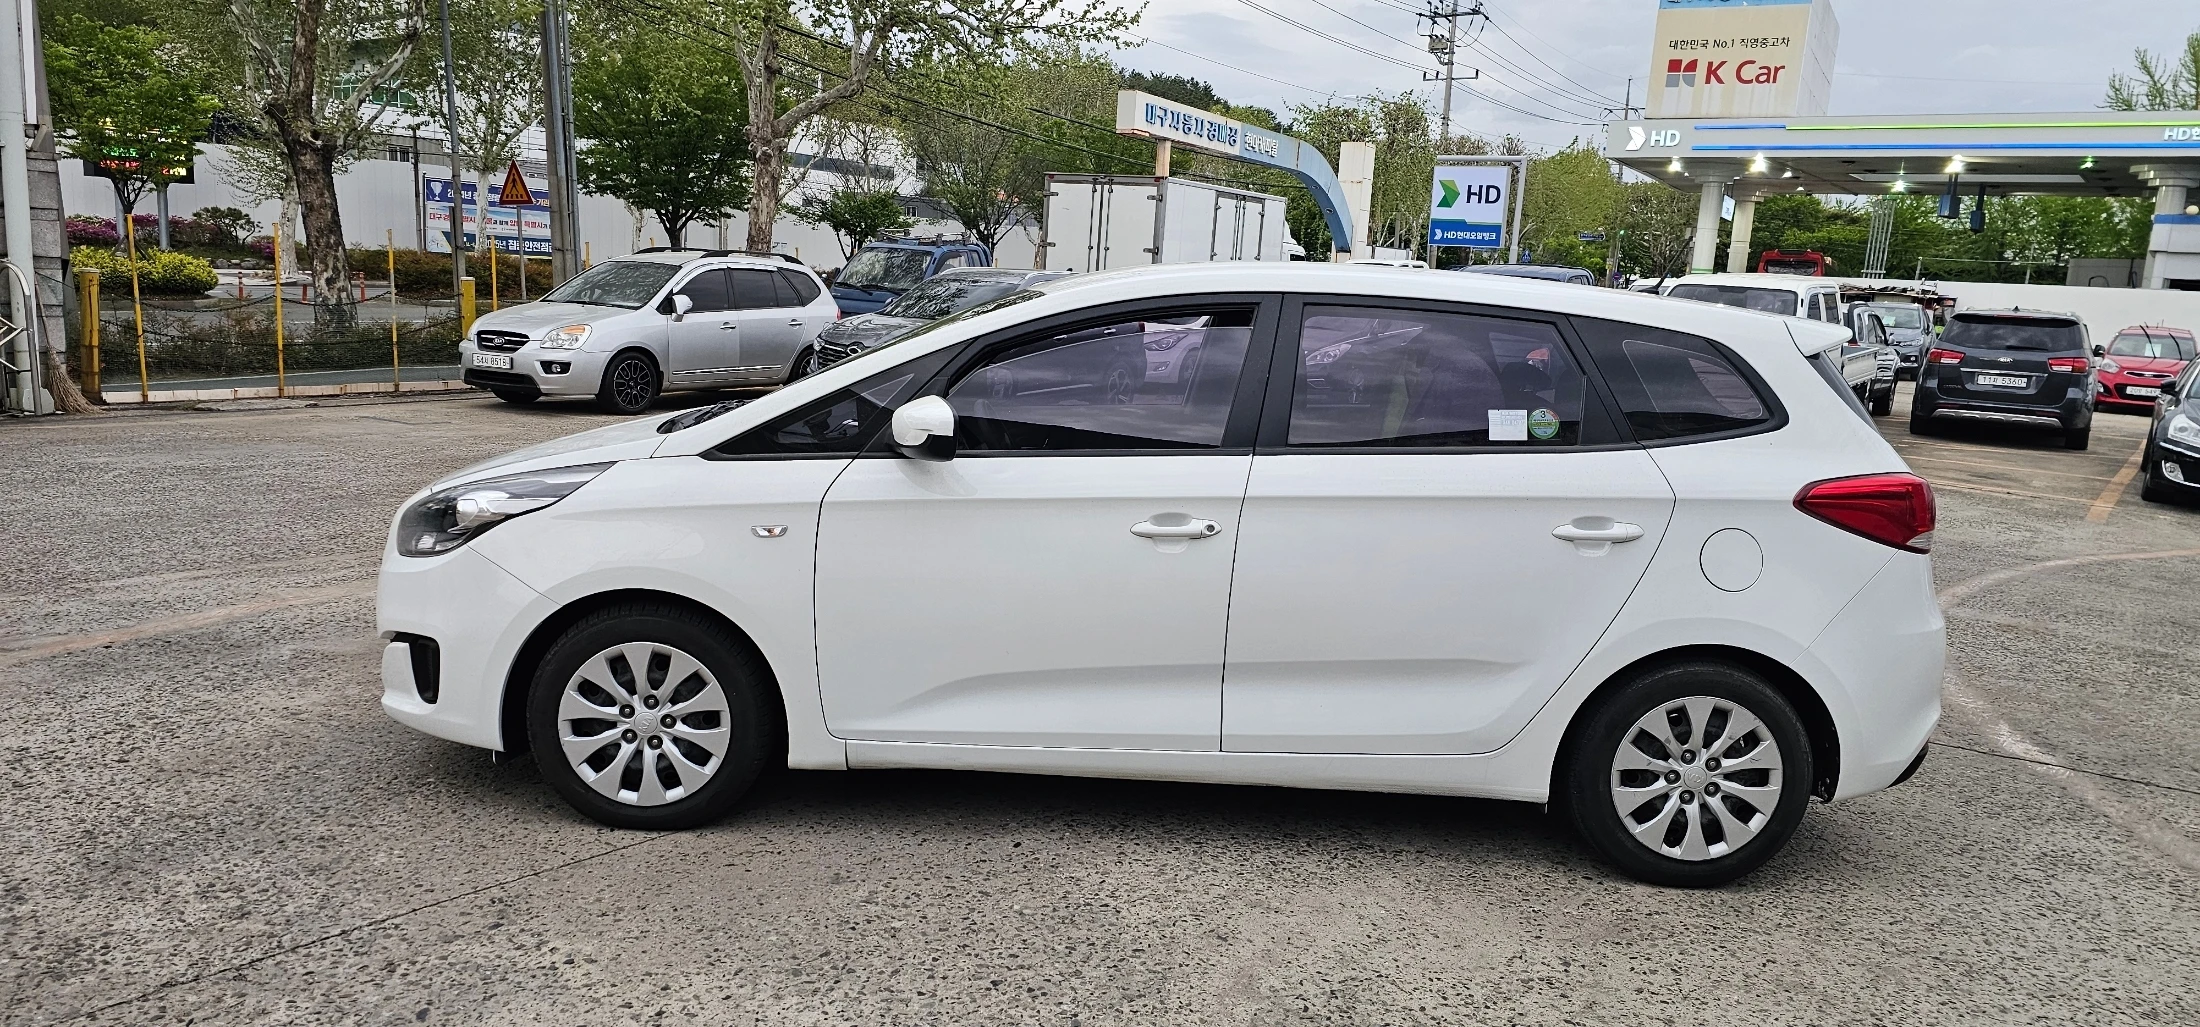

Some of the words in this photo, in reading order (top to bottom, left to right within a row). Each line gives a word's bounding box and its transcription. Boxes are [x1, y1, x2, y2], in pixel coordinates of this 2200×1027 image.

[1669, 39, 1709, 50] 대한민국
[1712, 38, 1735, 49] No.1
[1739, 36, 1791, 49] 직영중고차
[1704, 60, 1728, 85] K
[1735, 59, 1786, 85] Car
[1650, 129, 1681, 147] HD
[1466, 184, 1501, 204] HD
[1443, 230, 1497, 241] HD현대오일뱅크
[2001, 377, 2023, 386] 5360
[1540, 410, 1547, 418] 3
